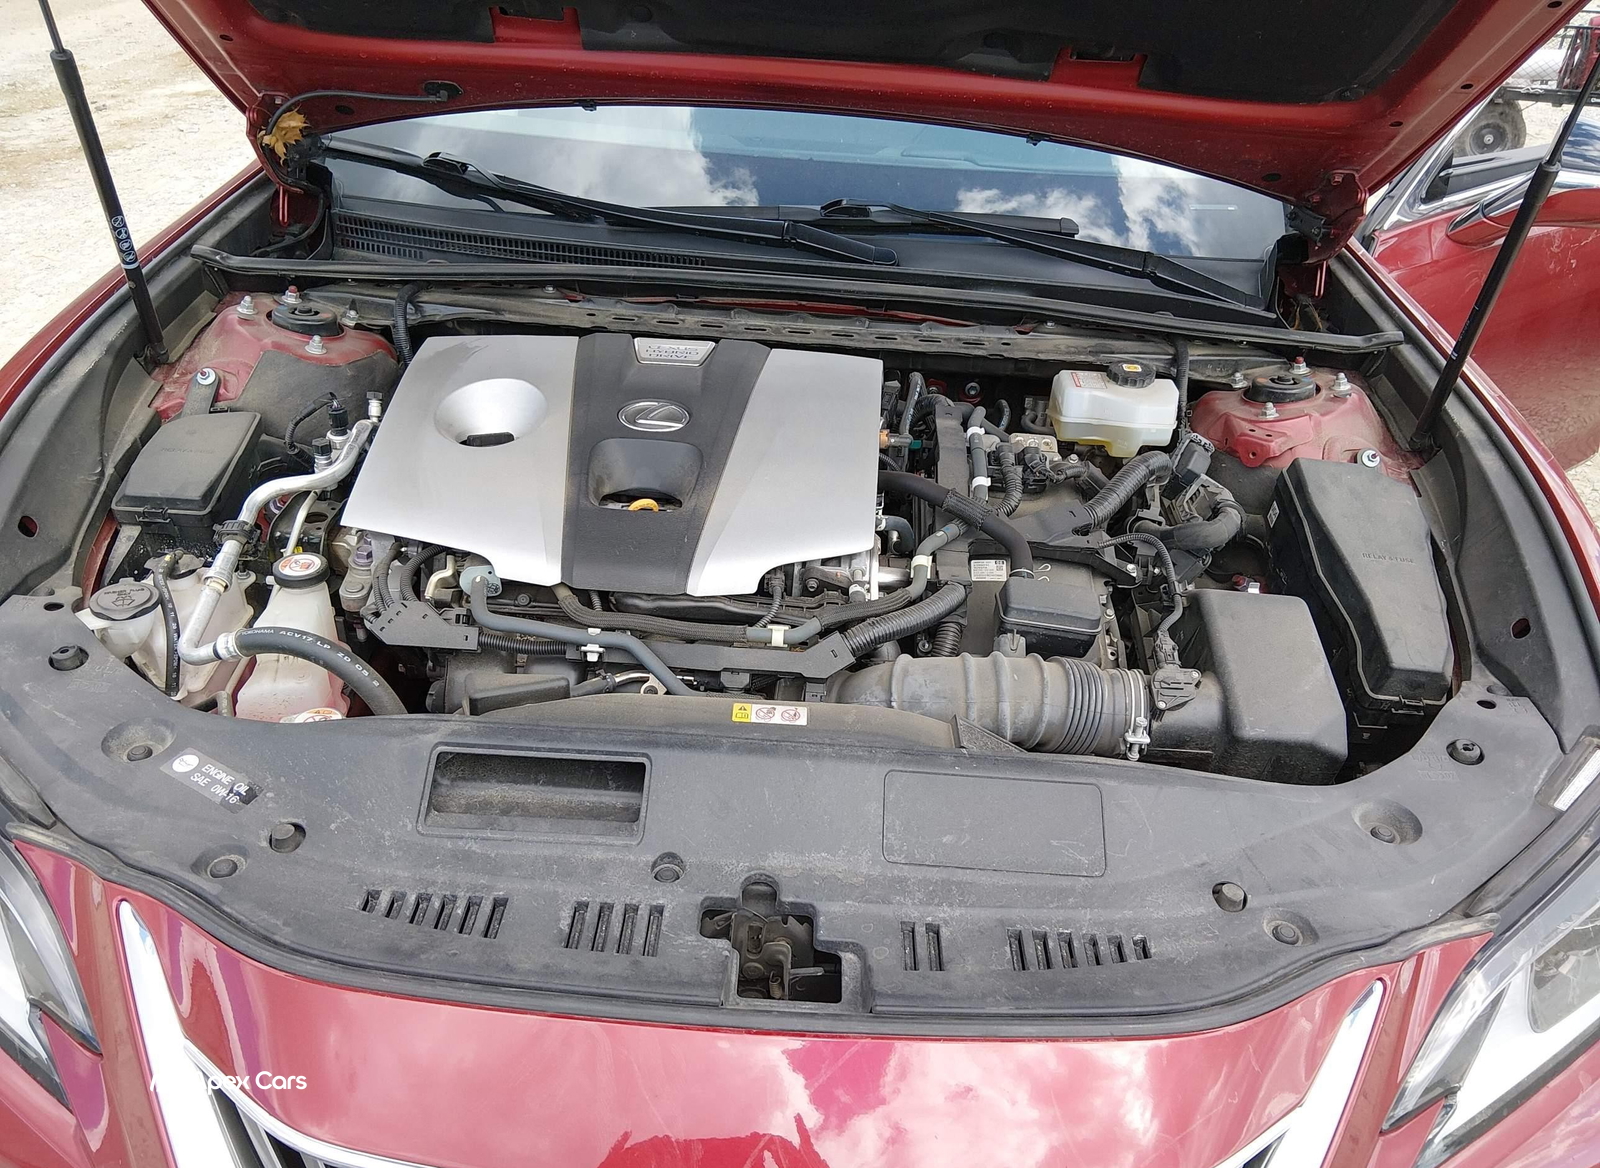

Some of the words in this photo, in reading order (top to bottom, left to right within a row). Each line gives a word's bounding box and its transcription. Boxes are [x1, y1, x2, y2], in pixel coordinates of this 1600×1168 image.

[1362, 552, 1387, 561] RELAY
[279, 630, 314, 641] ACV17
[316, 640, 331, 649] LP
[190, 772, 212, 787] SAE
[210, 784, 240, 804] 0W-16
[201, 763, 236, 785] ENGINE
[233, 782, 250, 796] OIL
